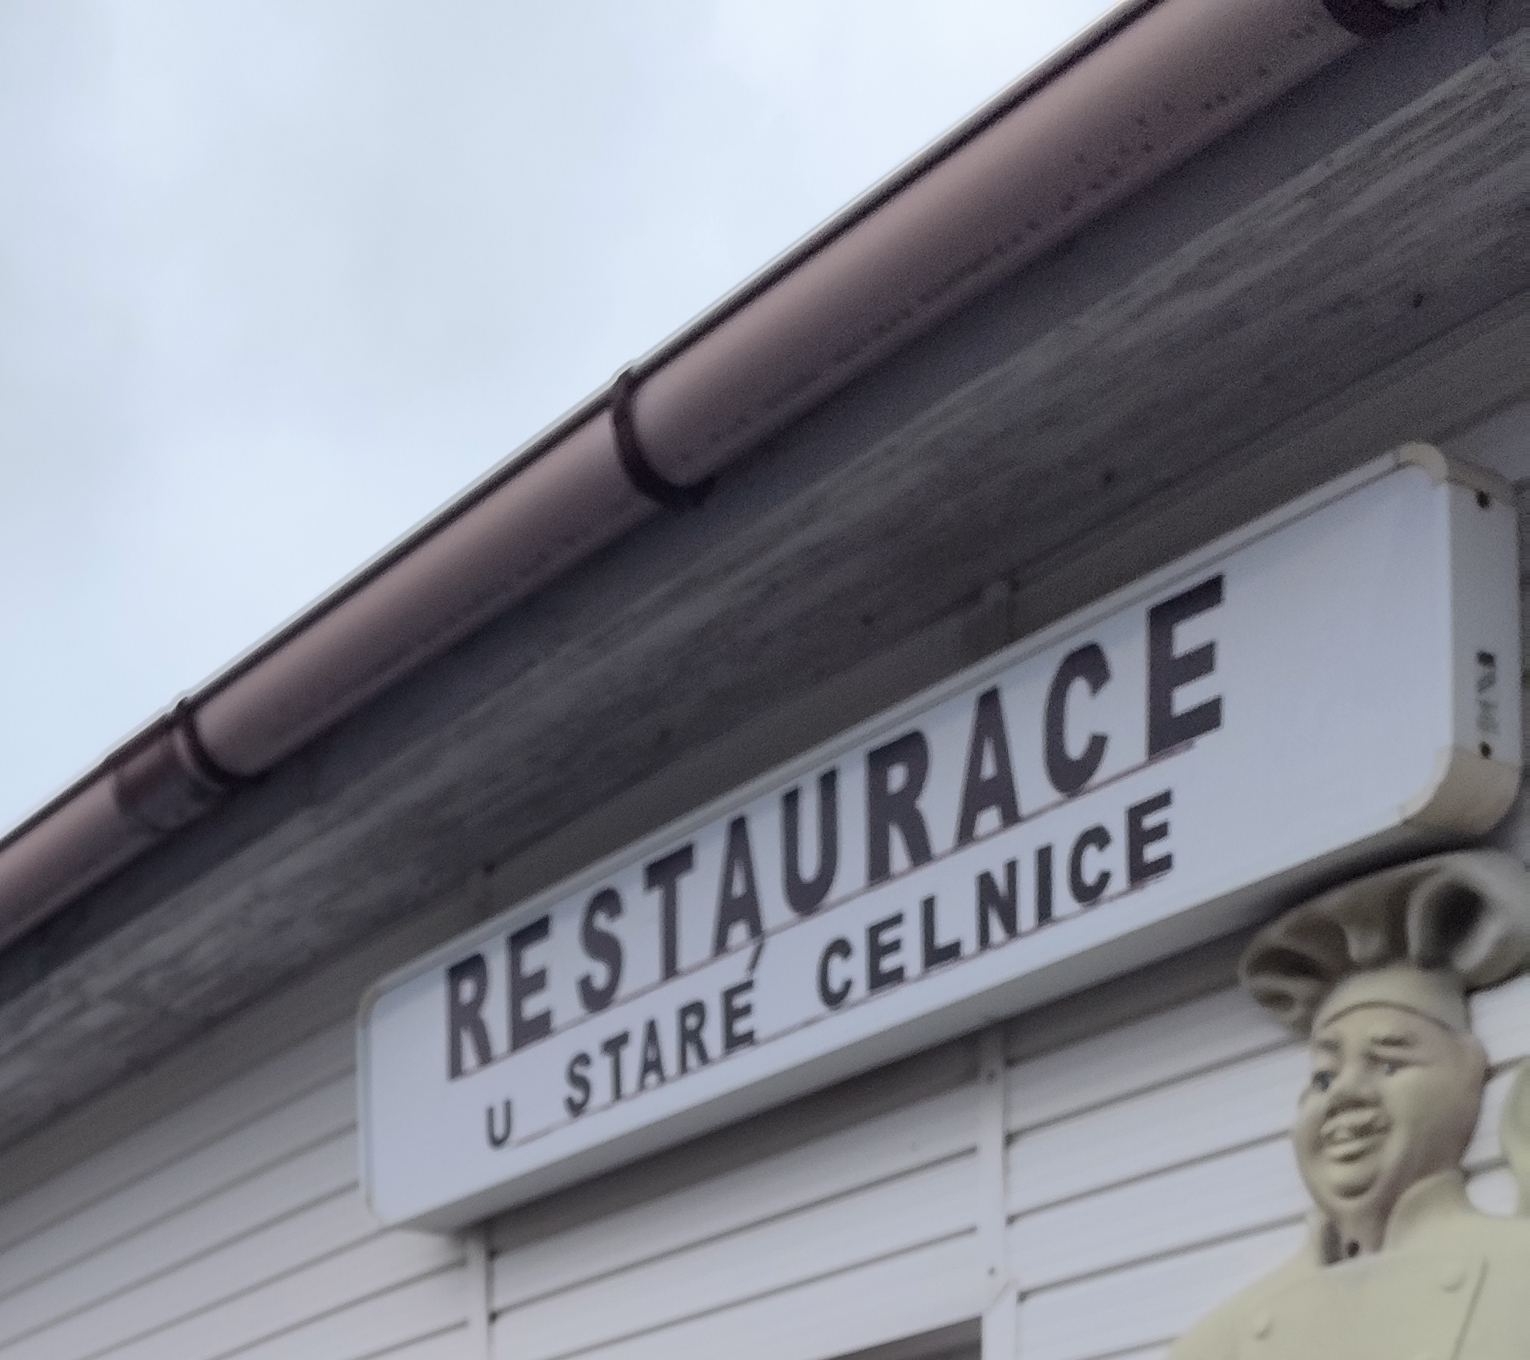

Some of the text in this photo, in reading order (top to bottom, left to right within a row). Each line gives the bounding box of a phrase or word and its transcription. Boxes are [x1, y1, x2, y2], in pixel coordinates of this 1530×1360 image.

[445, 573, 1226, 1082] RESTAURACE
[485, 790, 1176, 1150] U STARÉ CELNICE
